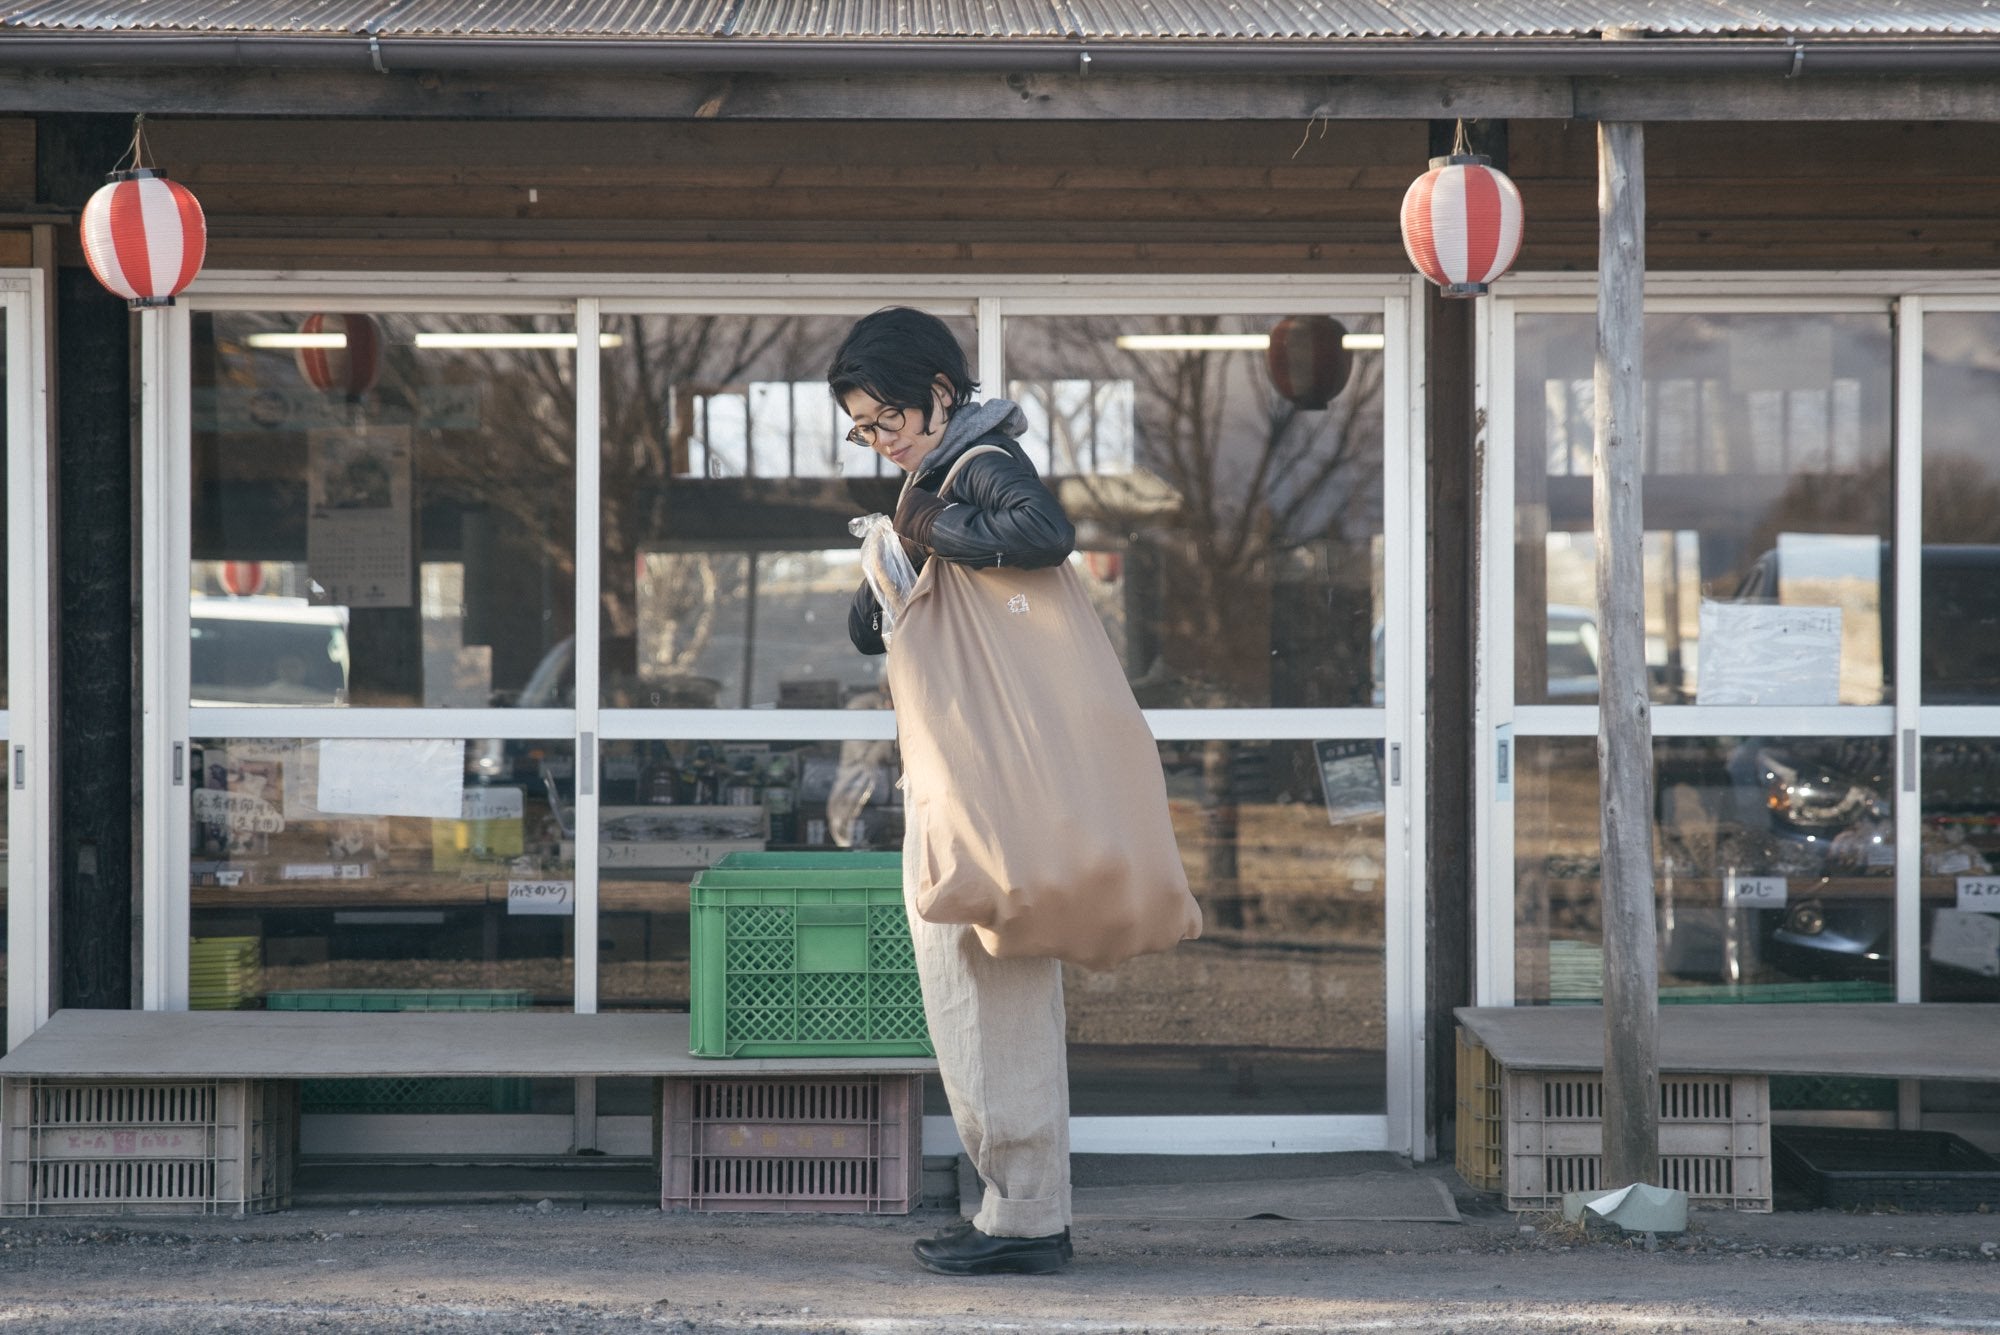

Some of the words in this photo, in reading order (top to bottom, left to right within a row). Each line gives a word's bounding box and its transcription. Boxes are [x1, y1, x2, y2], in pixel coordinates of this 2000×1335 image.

[510, 883, 567, 904] ふきのとう
